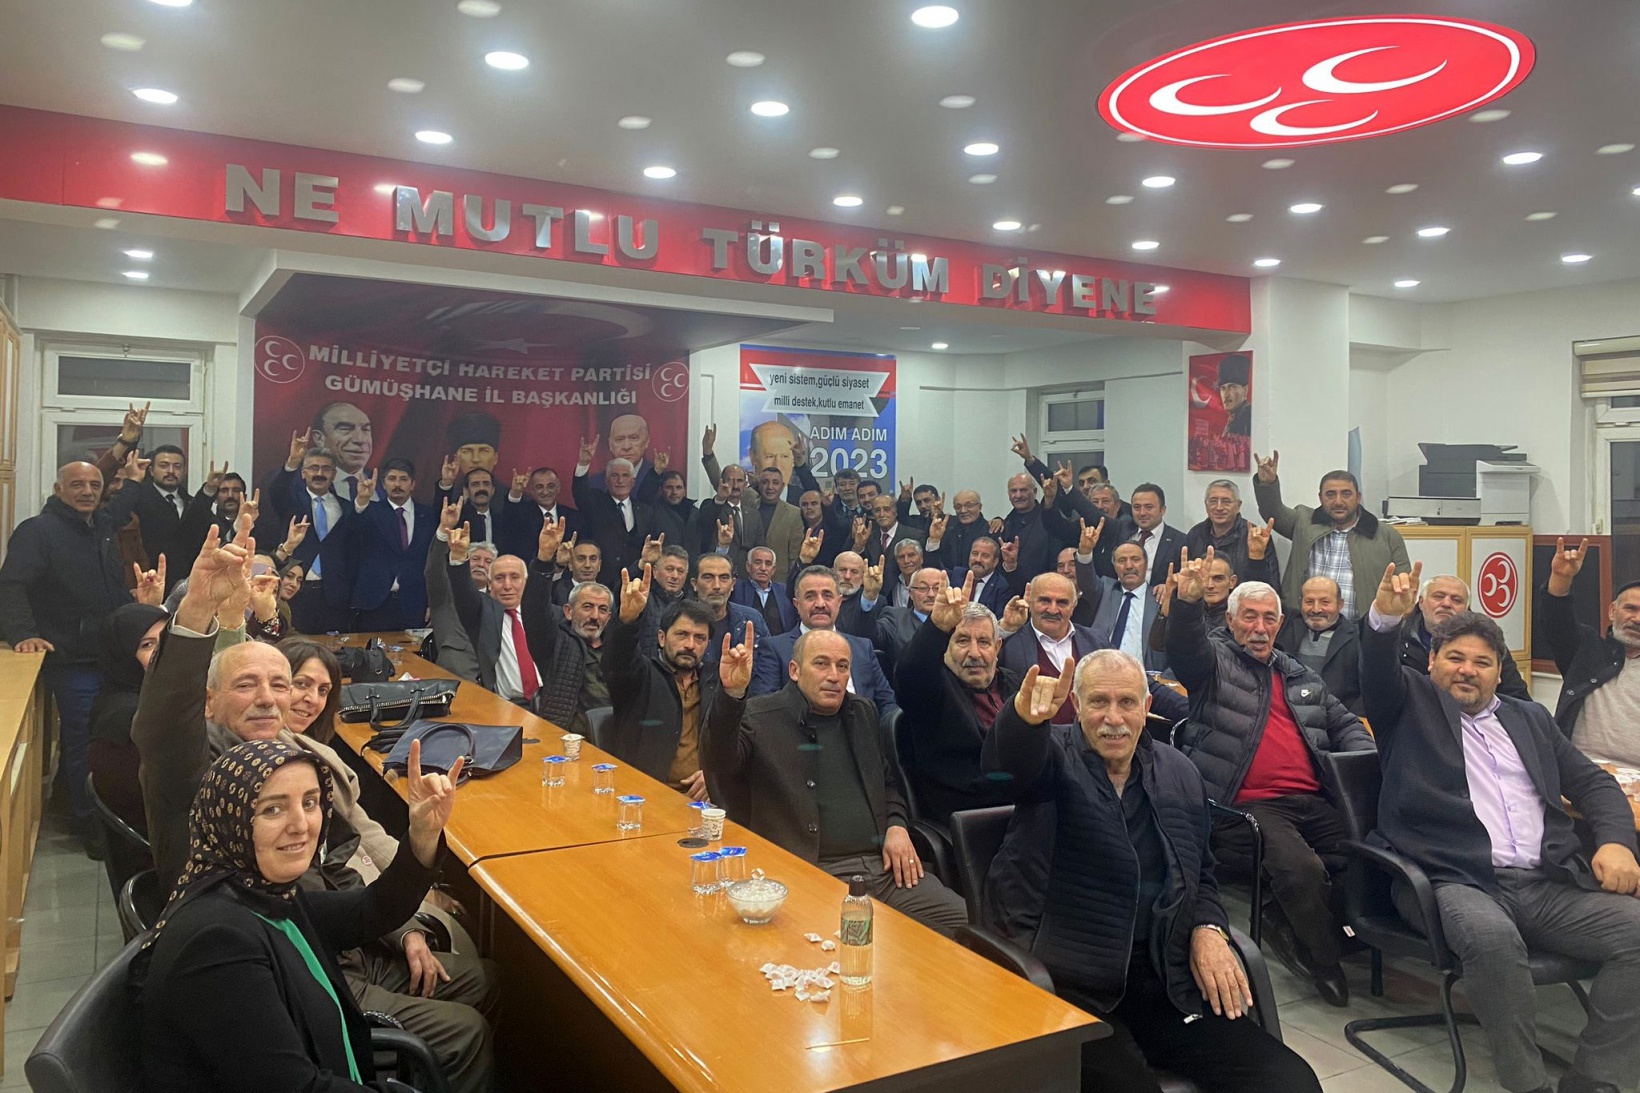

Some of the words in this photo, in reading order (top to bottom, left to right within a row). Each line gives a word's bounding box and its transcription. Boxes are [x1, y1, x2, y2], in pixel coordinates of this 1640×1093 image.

[225, 163, 339, 223] NE
[395, 185, 659, 260] MUTLU
[702, 220, 949, 294] TÜRKÜM
[982, 256, 1157, 314] DİYENE
[309, 345, 450, 376] MİLLİYETÇİ
[459, 364, 564, 382] HAREKET
[570, 363, 651, 382] PARTİSİ
[325, 374, 478, 402] GÜMÜŞHANE
[485, 386, 504, 403] İL
[512, 387, 637, 408] BAŞKANLIĞI
[769, 372, 787, 386] yeni
[842, 376, 870, 391] siyaset
[774, 396, 790, 407] milli
[791, 396, 837, 410] destek,kutlu
[838, 400, 864, 410] emanet
[810, 426, 847, 441] ADIM
[851, 428, 887, 442] ADIM
[809, 447, 888, 479] 2023
